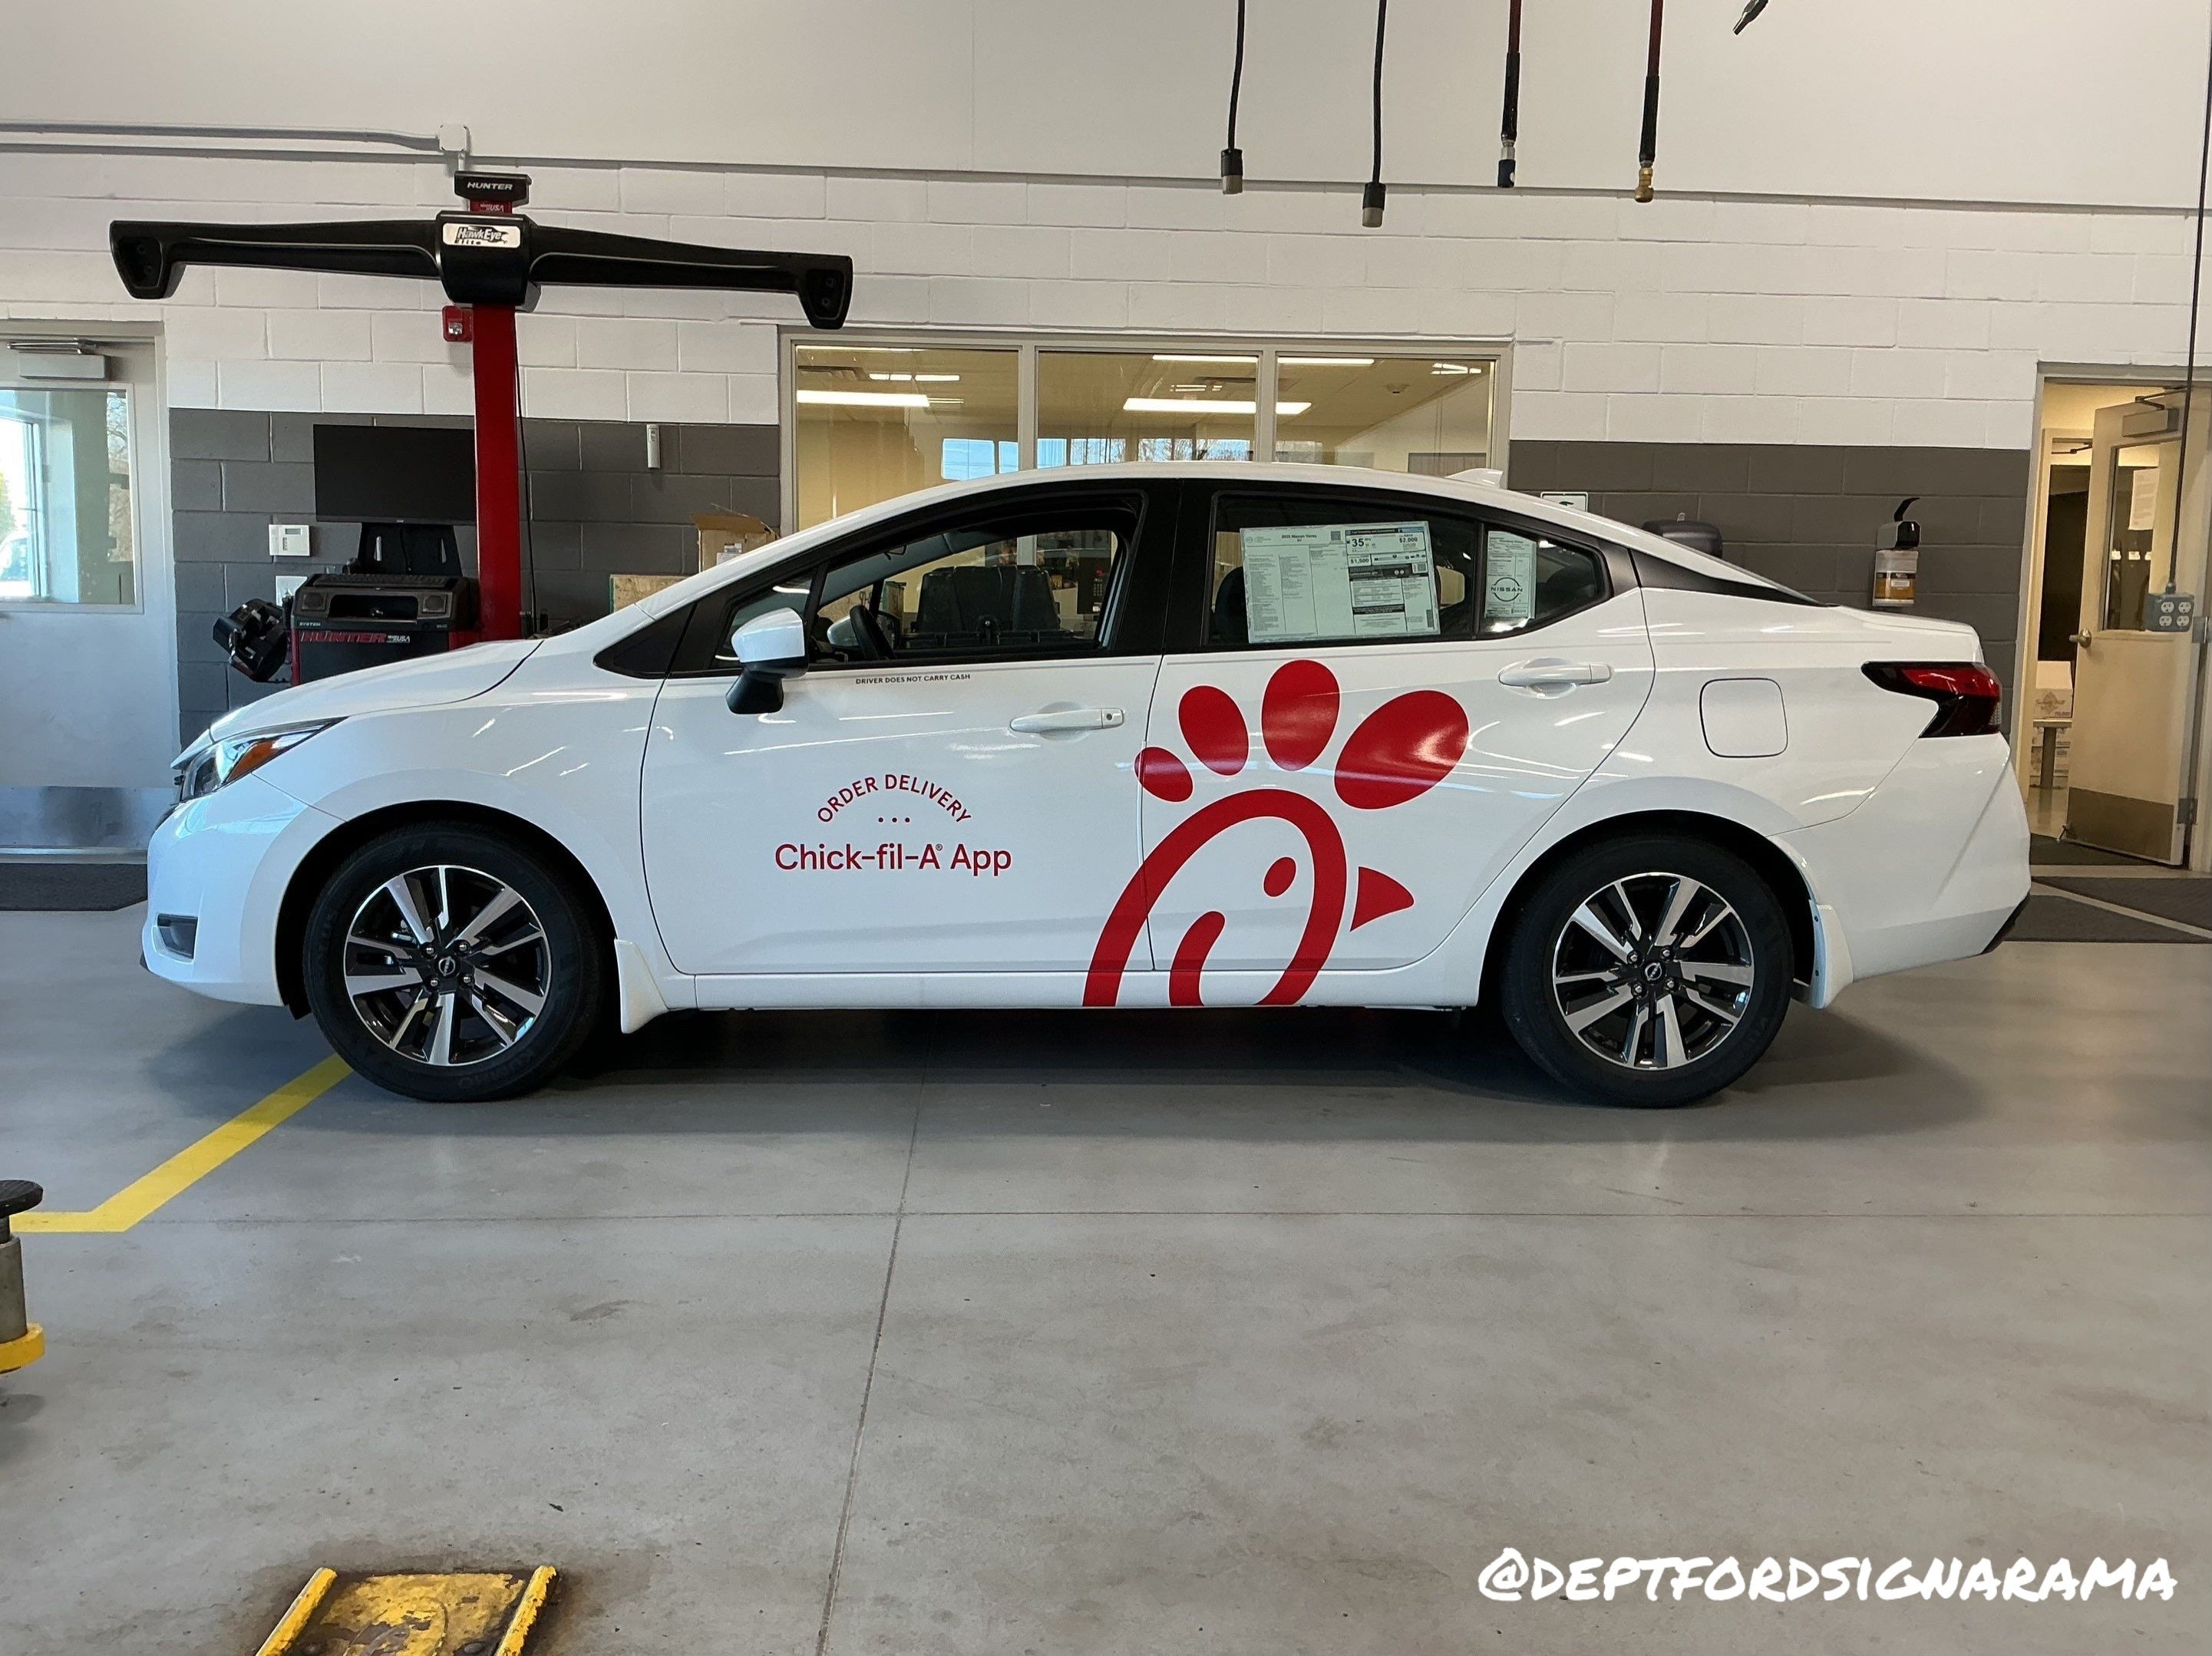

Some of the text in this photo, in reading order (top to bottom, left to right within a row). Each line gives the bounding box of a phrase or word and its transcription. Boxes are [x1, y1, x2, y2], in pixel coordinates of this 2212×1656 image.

[467, 182, 513, 190] HUNTER
[457, 226, 503, 241] HawkEye
[1352, 538, 1365, 547] 35
[300, 632, 387, 643] HUNTER
[817, 774, 972, 823] ORDER DELIVERY
[950, 843, 1012, 876] App
